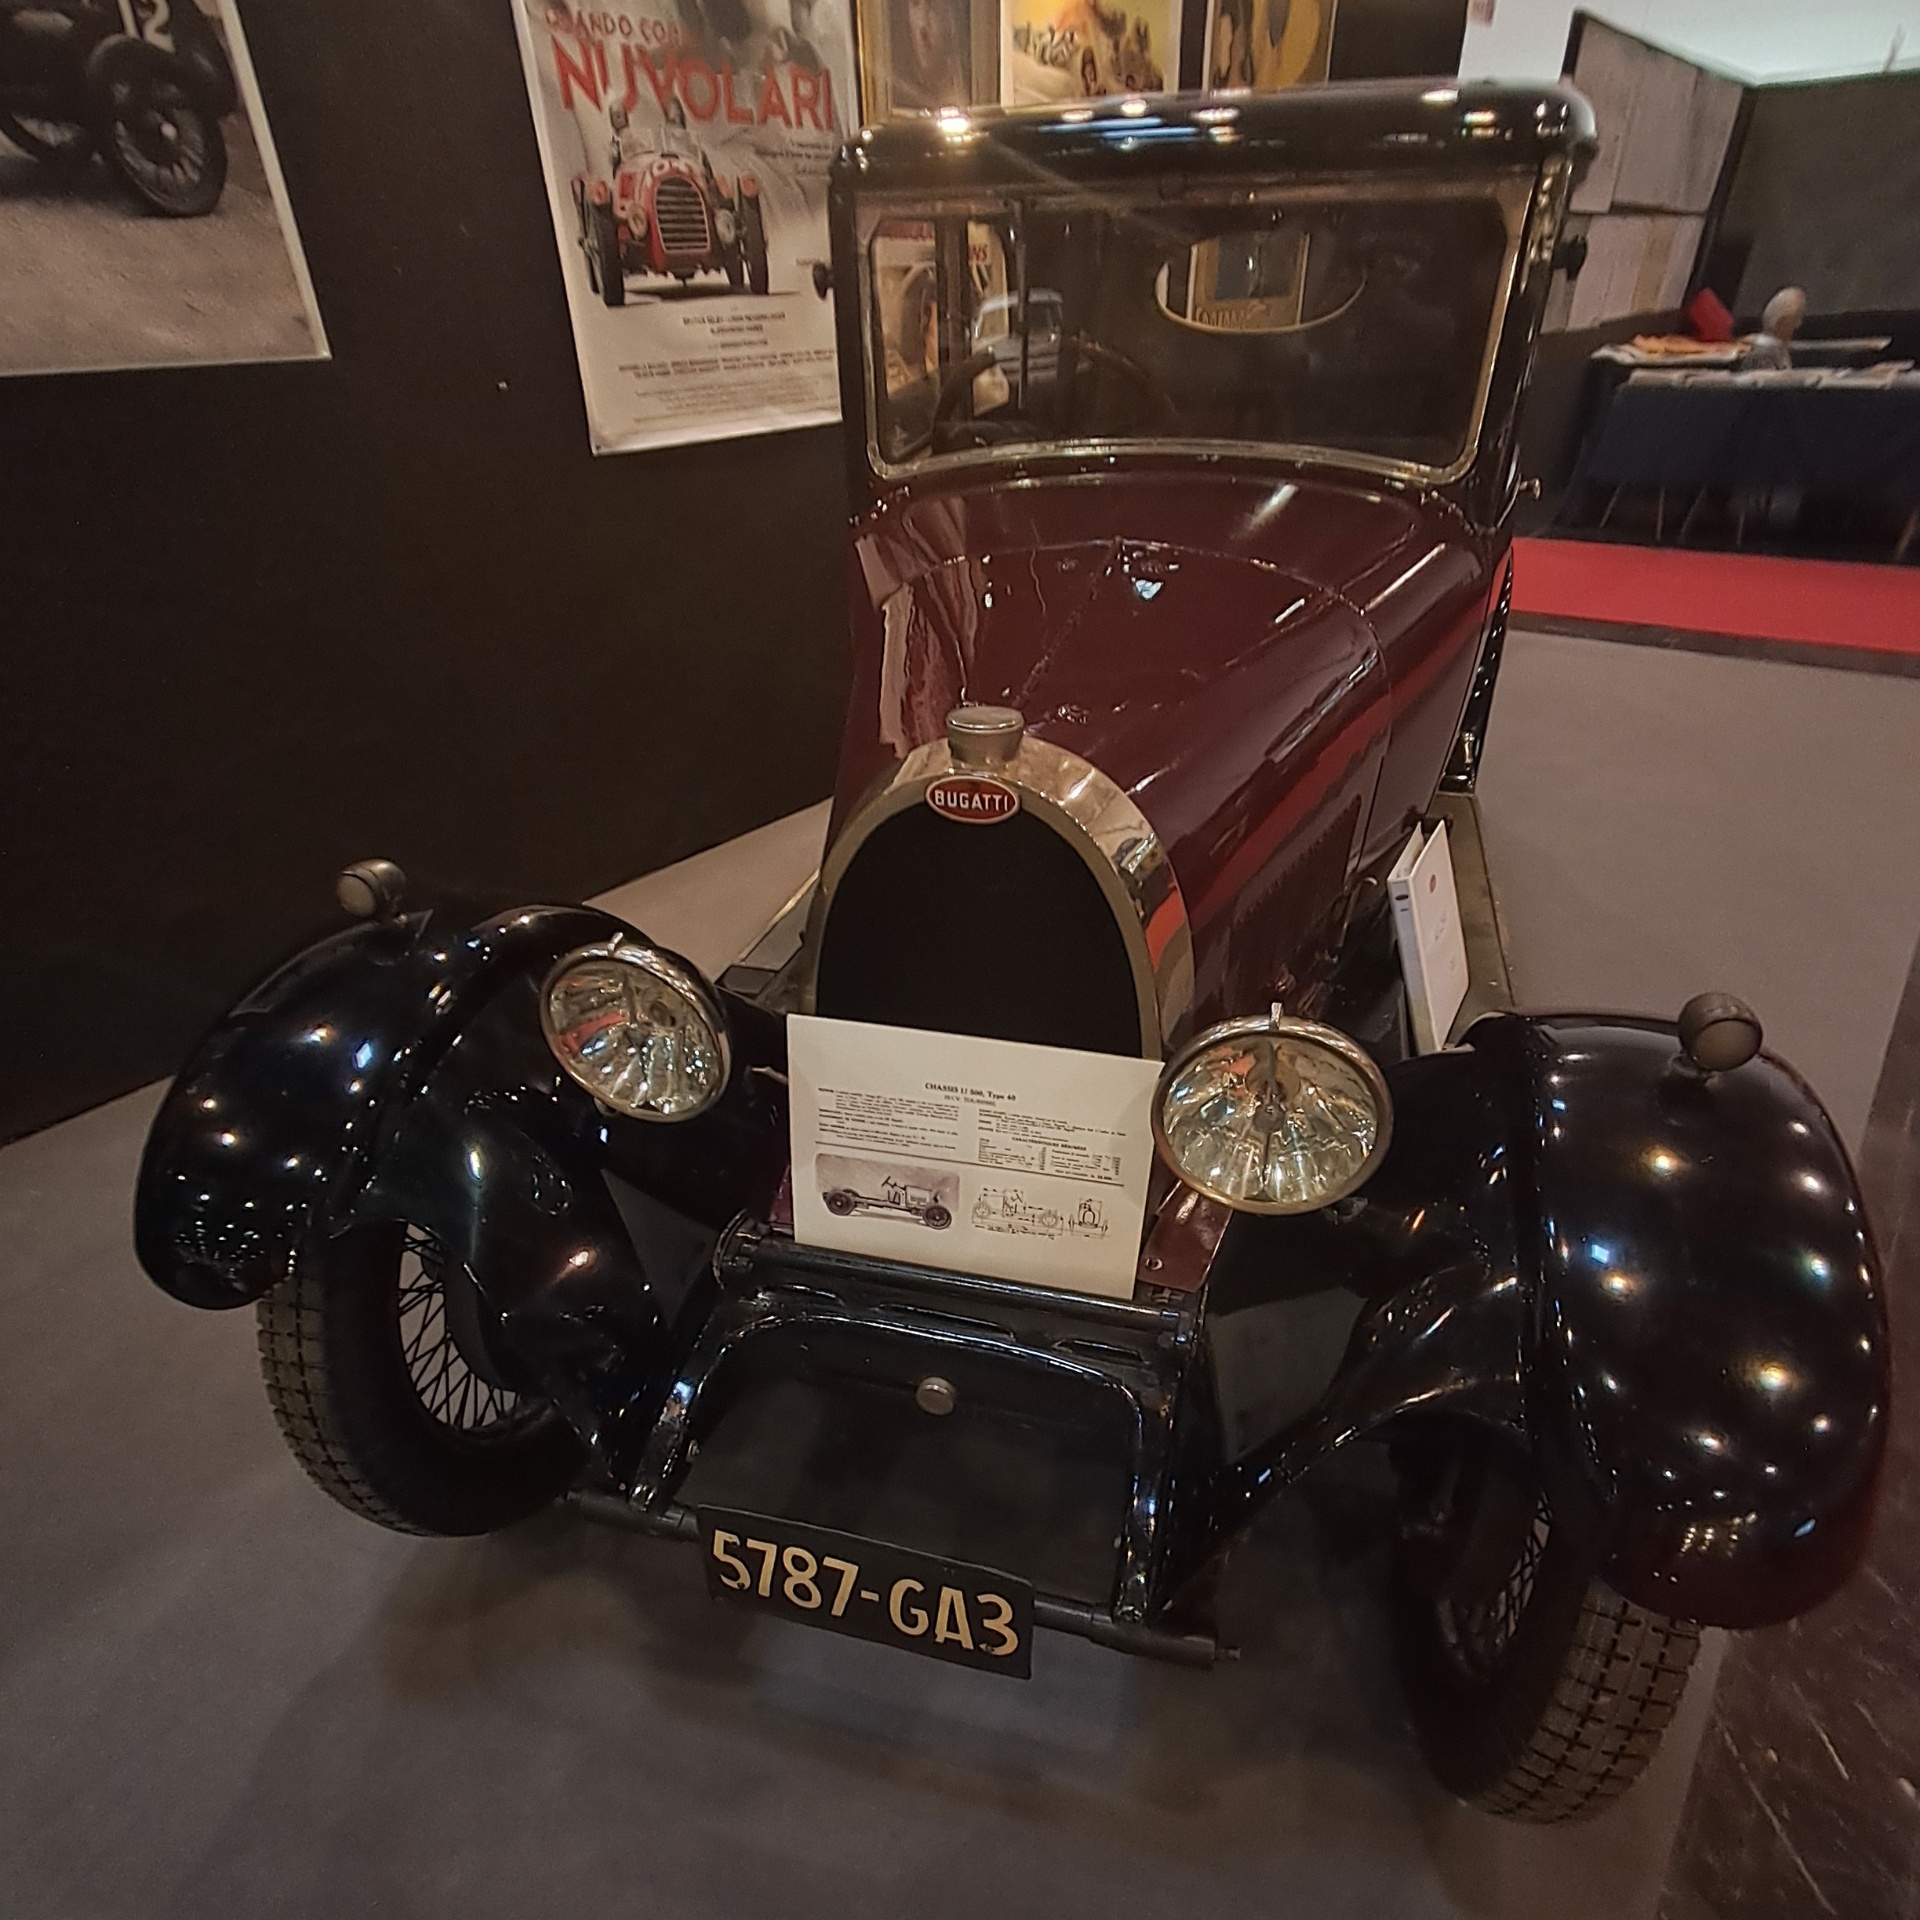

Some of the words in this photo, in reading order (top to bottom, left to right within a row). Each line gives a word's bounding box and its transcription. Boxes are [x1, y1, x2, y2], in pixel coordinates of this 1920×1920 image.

[551, 34, 834, 131] NUVOLARI
[934, 789, 1008, 812] BUGATTI
[713, 1530, 1019, 1656] 5787-GA3
